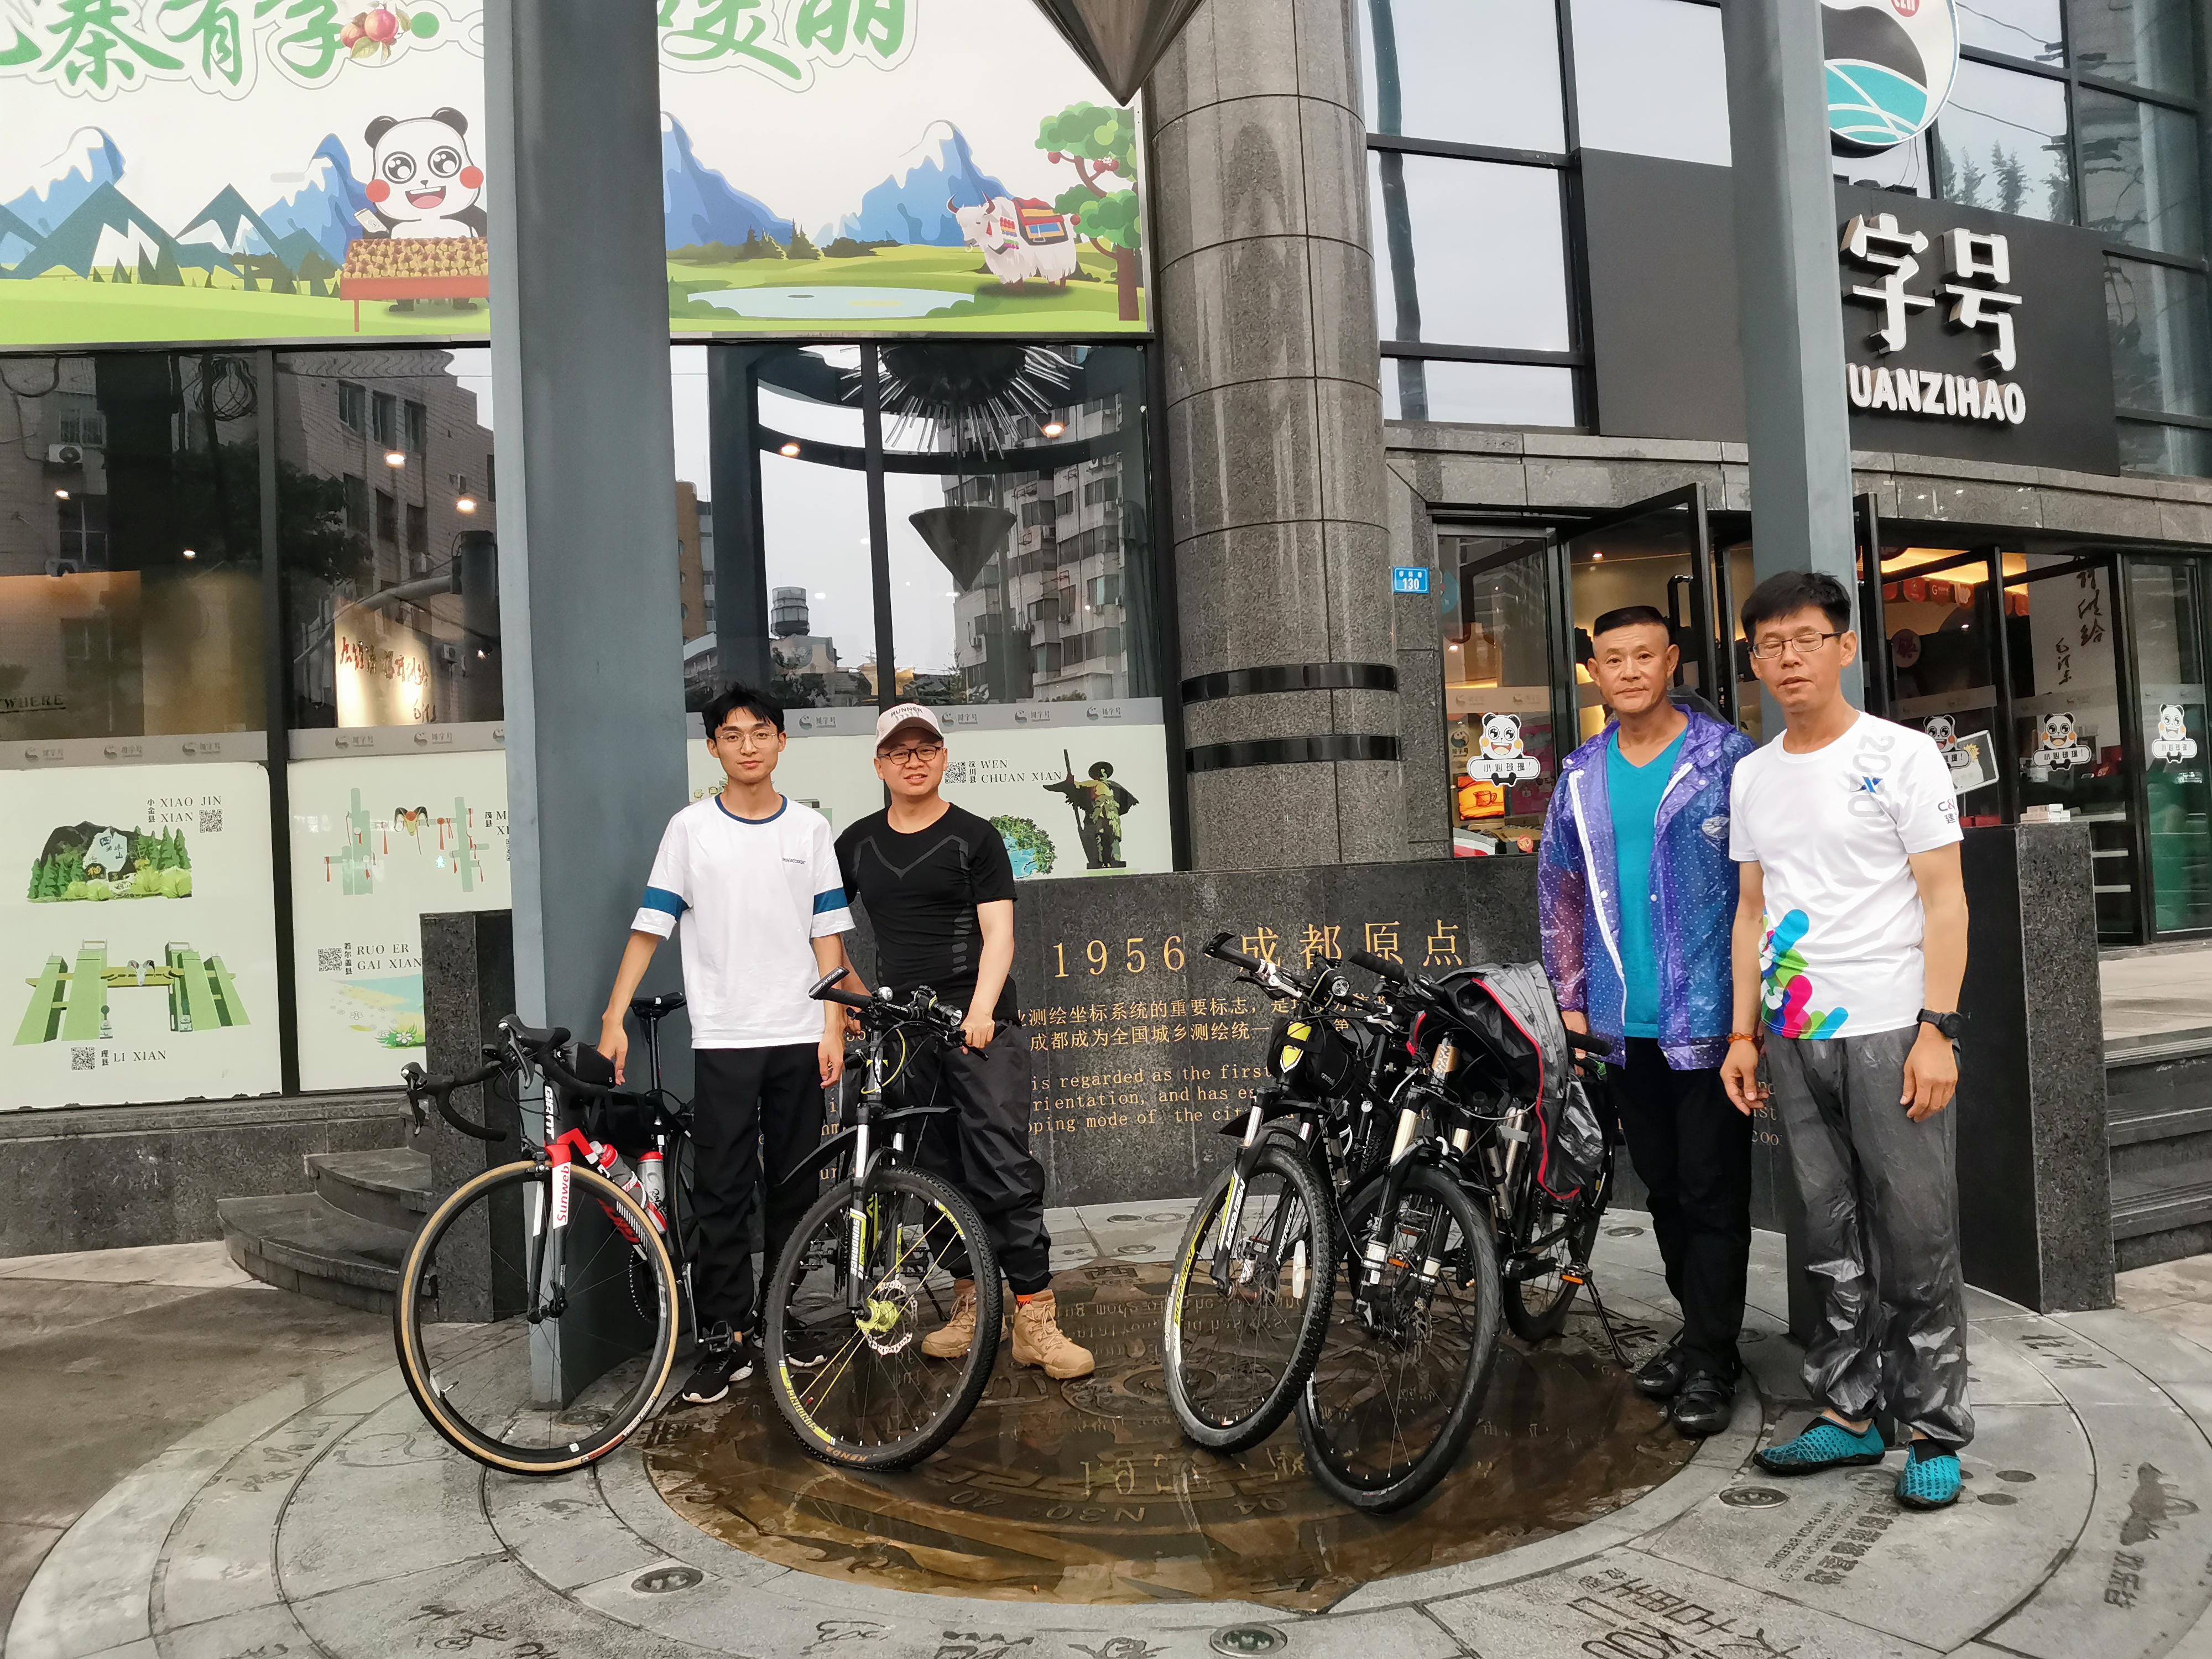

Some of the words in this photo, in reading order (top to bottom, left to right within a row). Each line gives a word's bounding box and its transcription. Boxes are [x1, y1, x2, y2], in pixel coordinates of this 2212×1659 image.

[1402, 578, 1420, 590] 130
[0, 695, 64, 708] WHERE
[891, 707, 923, 718] RUNNER
[968, 760, 977, 784] 汶川县
[980, 759, 1008, 769] WEN
[981, 773, 1025, 783] CHUAN
[1032, 771, 1062, 781] XIAN
[160, 797, 194, 808] XIAO
[201, 795, 222, 806] JIN
[147, 798, 155, 823] 小金县
[160, 812, 194, 823] XIAN
[496, 811, 507, 820] M
[497, 825, 509, 835] XI
[357, 944, 385, 956] RUO
[393, 943, 410, 954] ER
[1053, 935, 1186, 978] 1956
[1239, 919, 1463, 973] 成都原点
[344, 942, 353, 975] 若尔盖县
[357, 959, 381, 971] GAI
[389, 957, 422, 969] XIAN
[1030, 1020, 1270, 1052] 成都成为全国城乡测绘统一
[101, 1050, 109, 1066] 理县
[113, 1052, 126, 1062] LI
[133, 1050, 166, 1061] XIAN
[1031, 1075, 1050, 1091] is
[1059, 1068, 1144, 1092] regarded
[1152, 1071, 1172, 1083] as
[1182, 1066, 1211, 1081] the
[1220, 1063, 1273, 1079] first
[1030, 1093, 1145, 1113] rientation,
[1158, 1087, 1191, 1103] and
[1197, 1085, 1228, 1100] has
[1237, 1086, 1257, 1099] es
[545, 1085, 555, 1140] GIANT
[1086, 1113, 1128, 1129] mode
[1136, 1109, 1157, 1125] of
[1174, 1108, 1204, 1123] the
[557, 1165, 570, 1223] Sunweb
[1225, 1177, 1246, 1251] MERIDA
[1276, 1196, 1297, 1266] MERIDA
[850, 1218, 860, 1276] SUNDANCE
[825, 1445, 869, 1462] KENDA
